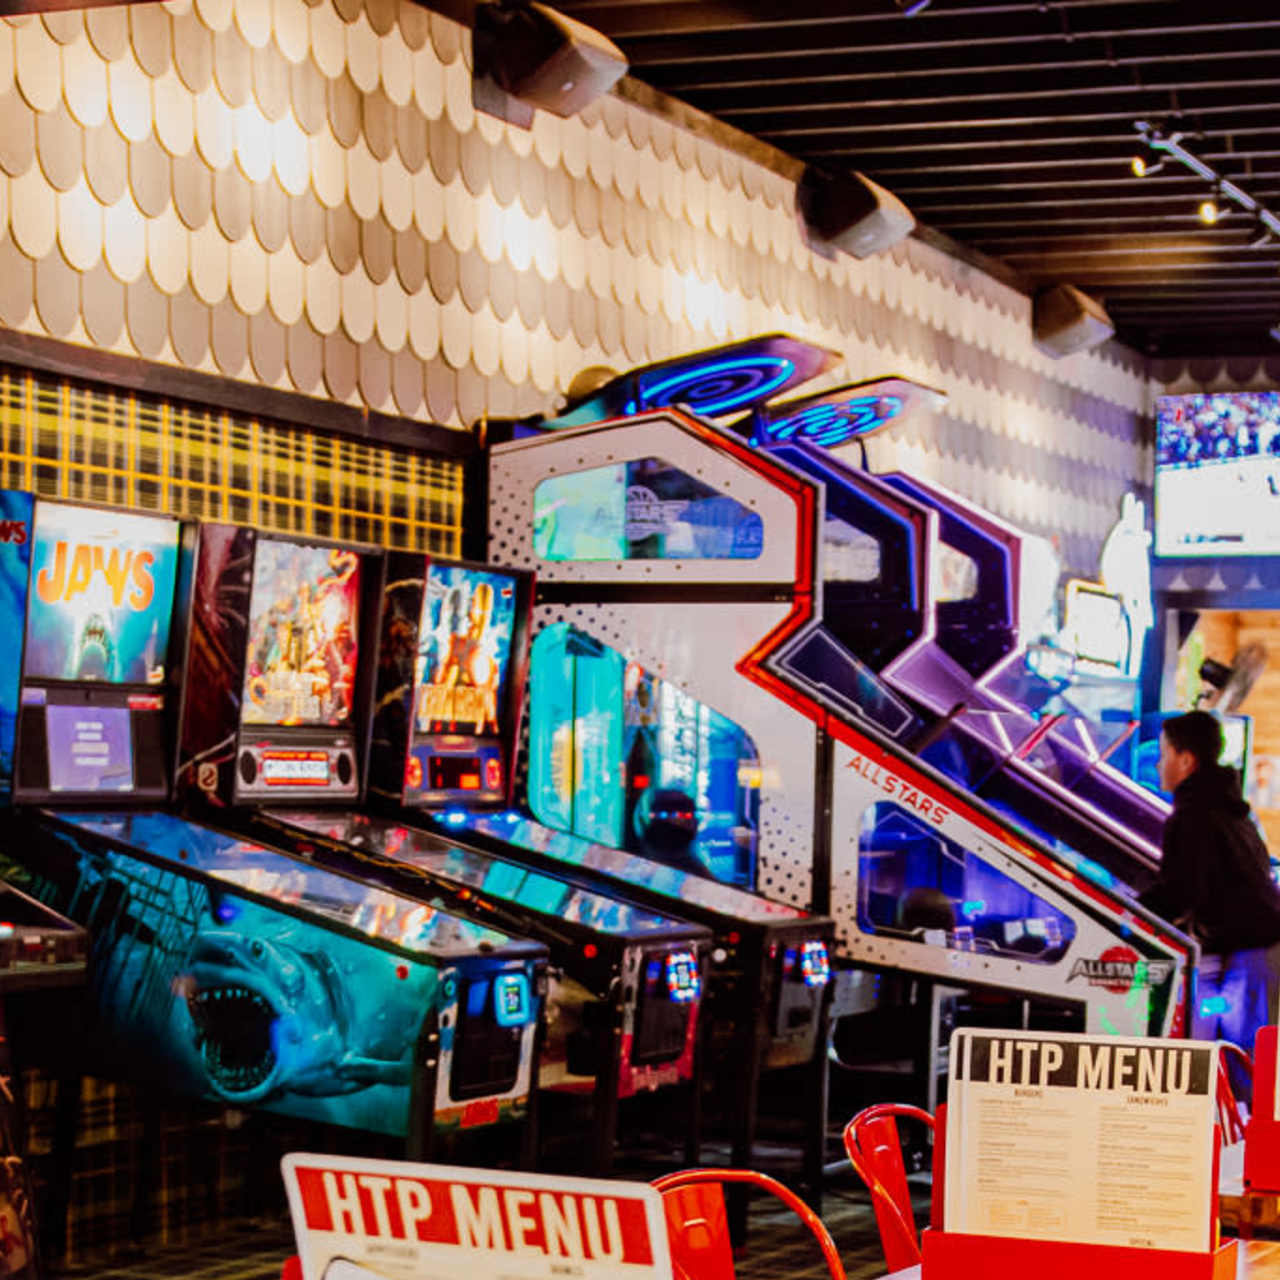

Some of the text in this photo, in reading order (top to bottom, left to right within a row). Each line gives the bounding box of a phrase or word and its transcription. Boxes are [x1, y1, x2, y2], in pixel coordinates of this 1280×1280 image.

[36, 541, 155, 611] JAWS
[989, 1040, 1192, 1096] HTP MENU
[322, 1170, 626, 1261] HTP MENU
